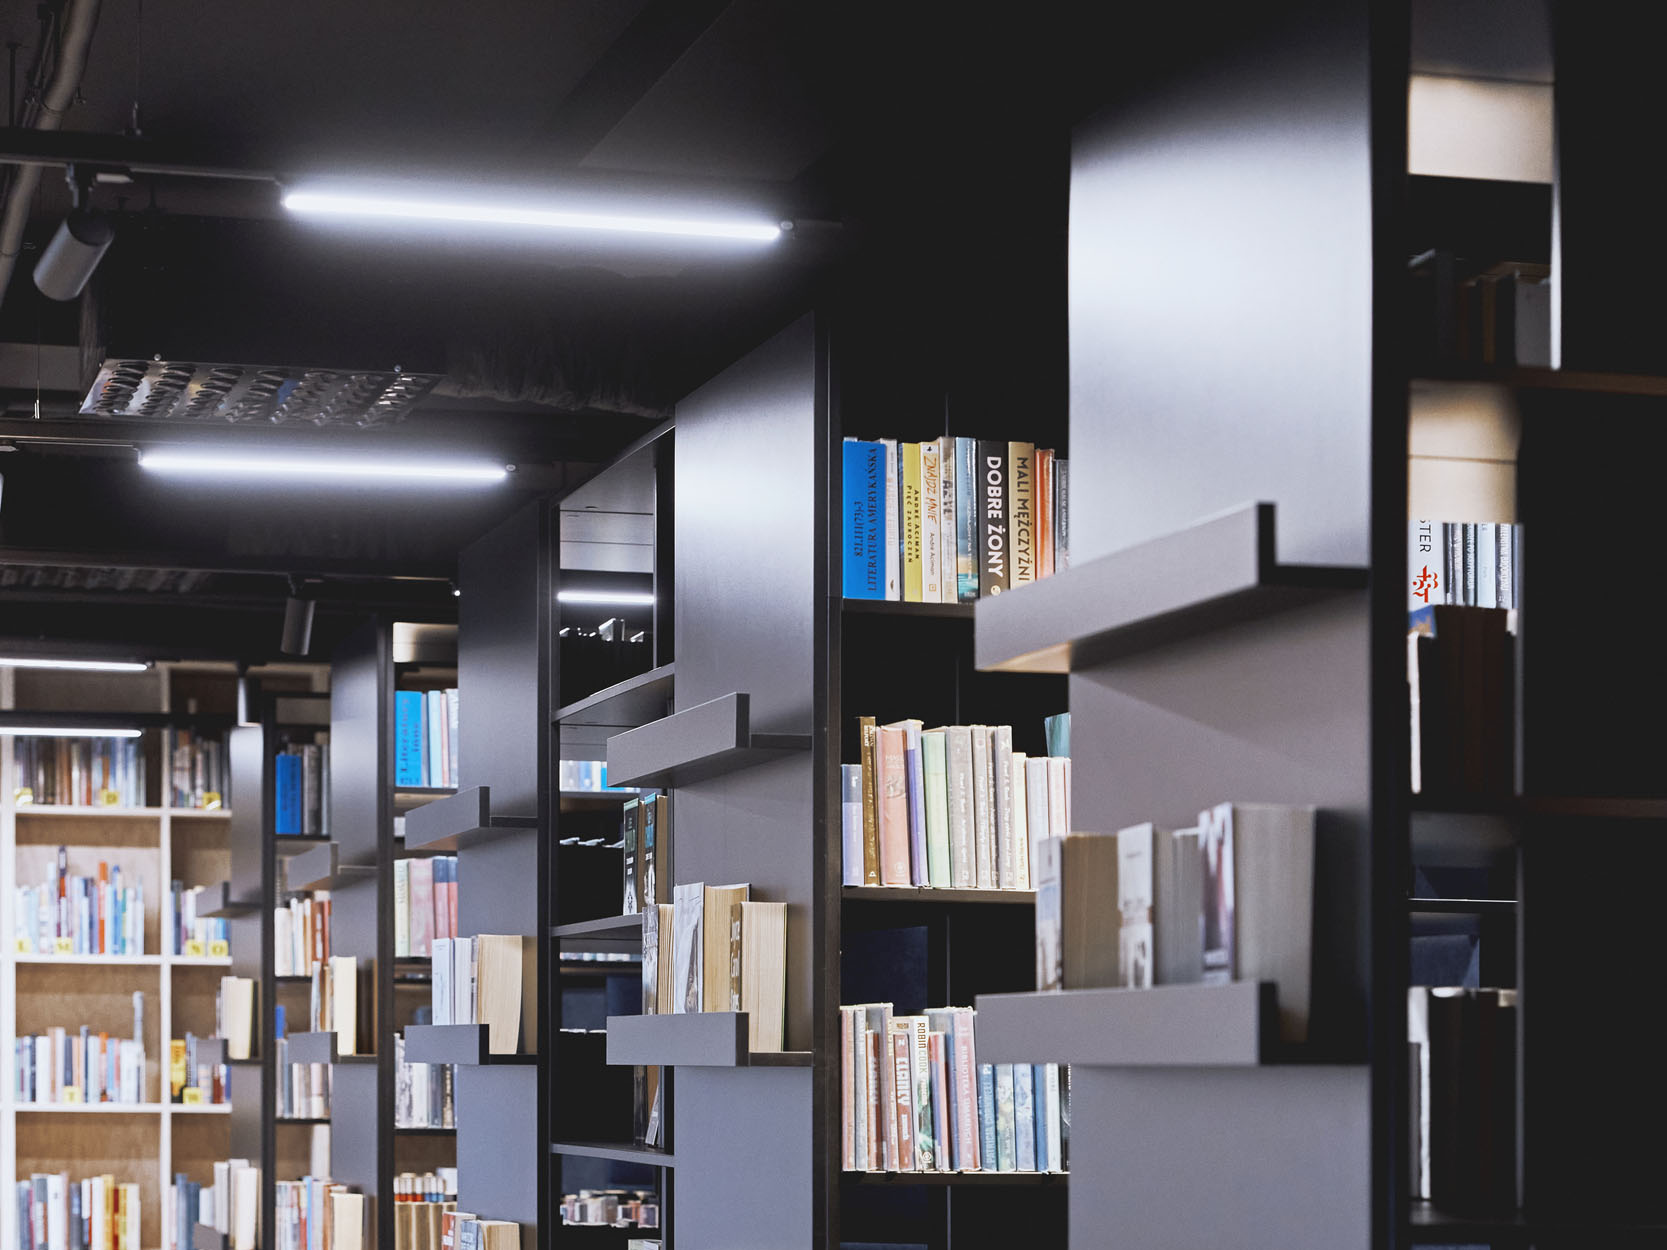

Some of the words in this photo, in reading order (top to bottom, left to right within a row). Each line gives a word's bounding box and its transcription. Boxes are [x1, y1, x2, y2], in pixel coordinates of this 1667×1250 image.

[865, 447, 877, 524] AMERYKAŃSKA
[987, 456, 1002, 519] DOBRE
[1017, 456, 1029, 493] MALI
[925, 497, 938, 525] MNIE
[987, 523, 1006, 578] ŻONY
[1419, 520, 1432, 553] TER
[867, 528, 877, 591] LITERATURA
[917, 1022, 926, 1049] ROBIN
[896, 1057, 910, 1106] CLANCY
[918, 1050, 928, 1074] COOK
[961, 1045, 970, 1095] BIBLIOTEKA
[985, 1127, 996, 1163] PATRICIA
